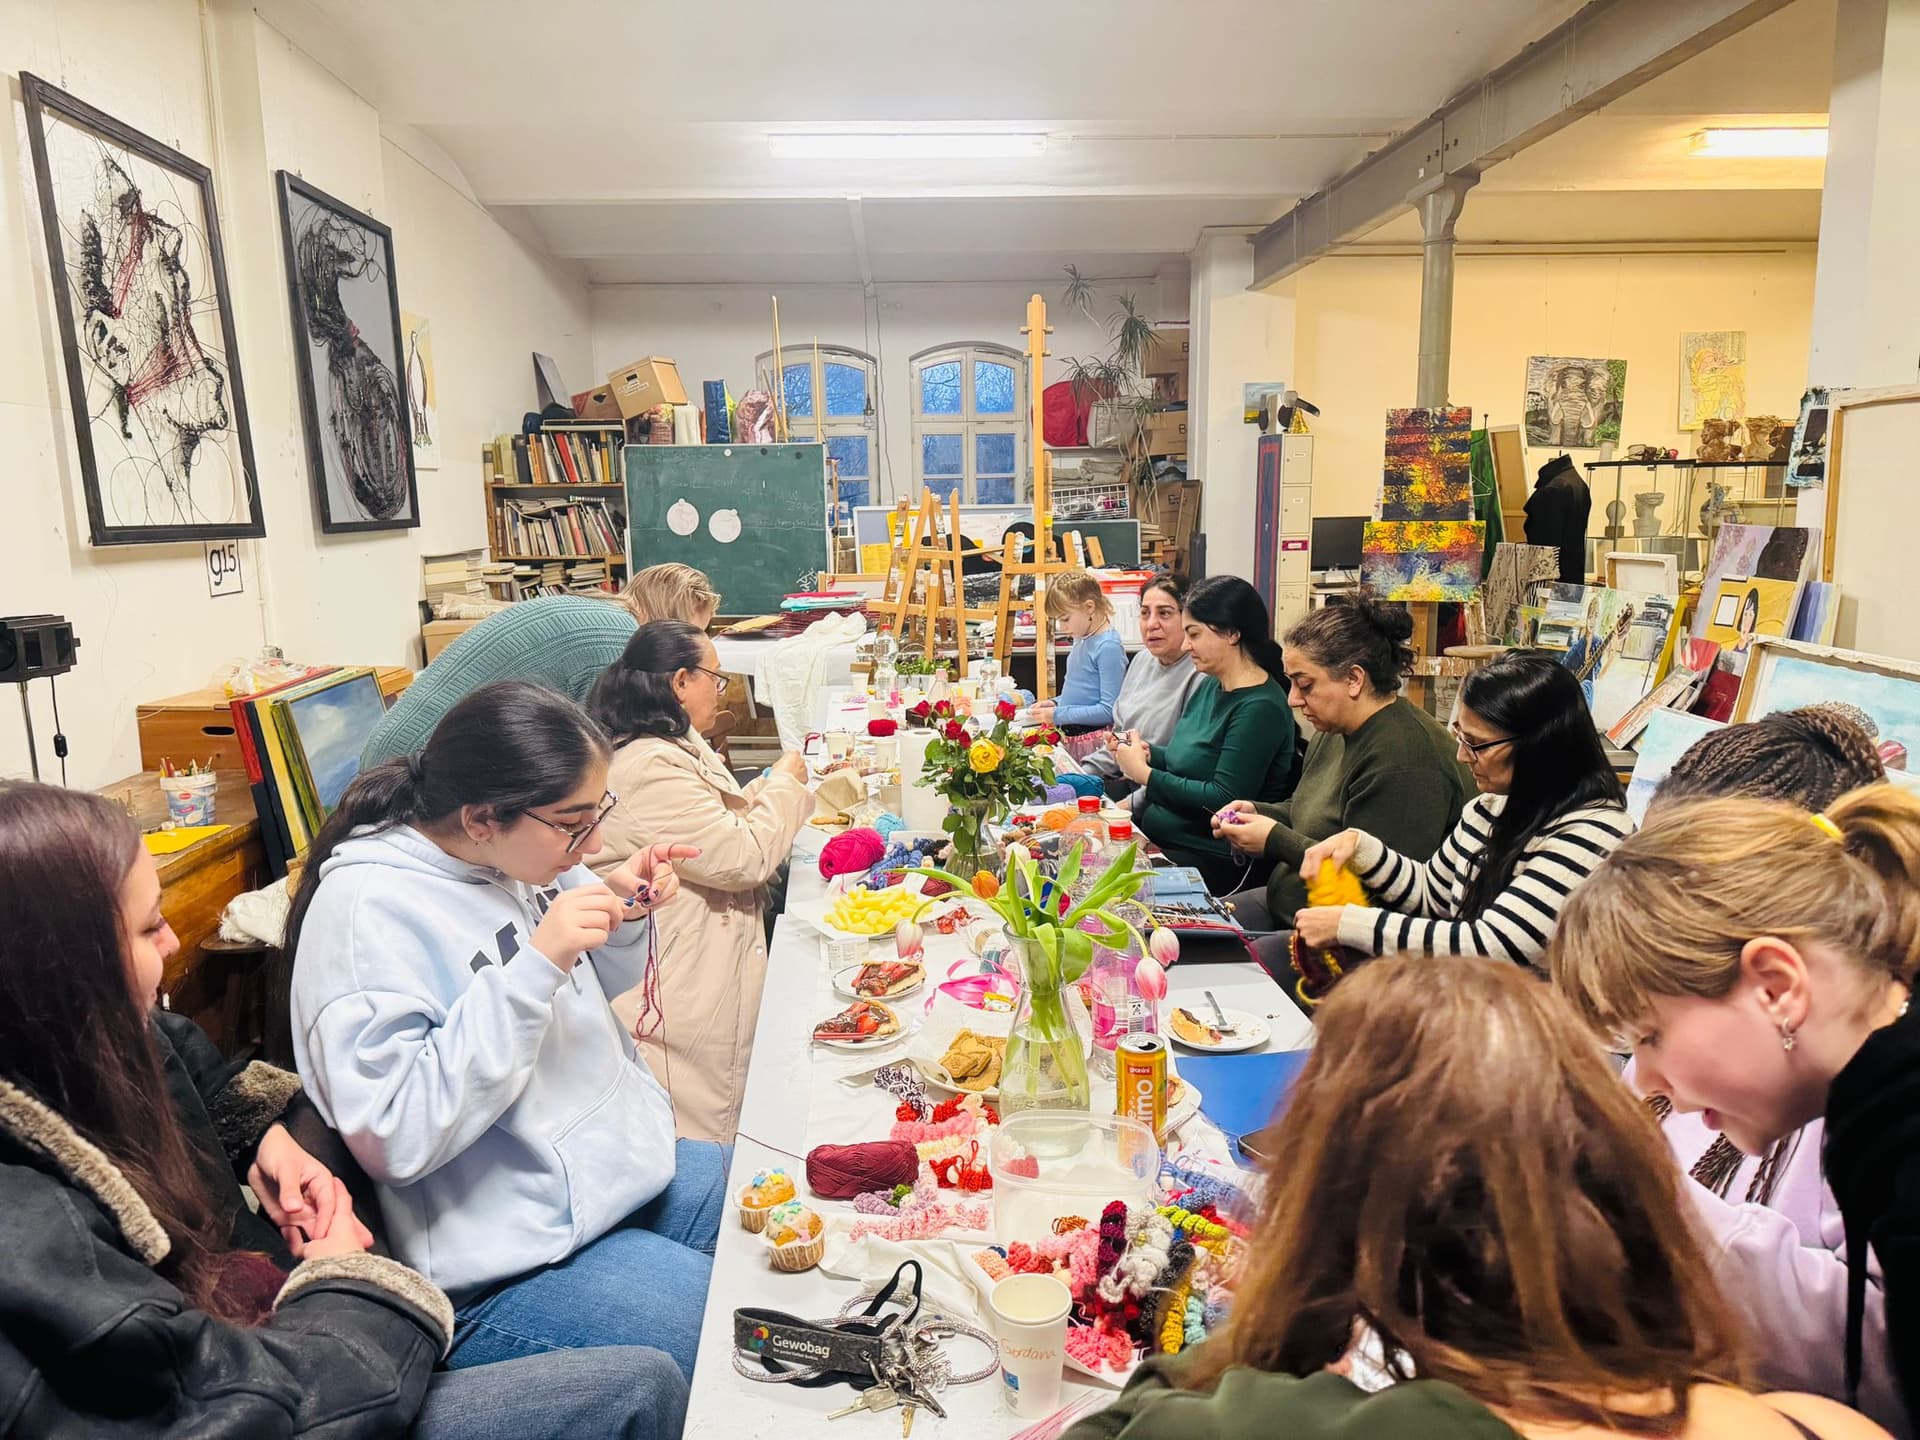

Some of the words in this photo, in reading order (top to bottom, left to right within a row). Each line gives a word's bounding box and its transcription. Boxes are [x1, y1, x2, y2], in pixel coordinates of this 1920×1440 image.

[210, 543, 236, 585] g15
[1136, 1079, 1153, 1126] imo
[772, 1335, 831, 1359] Gewobag
